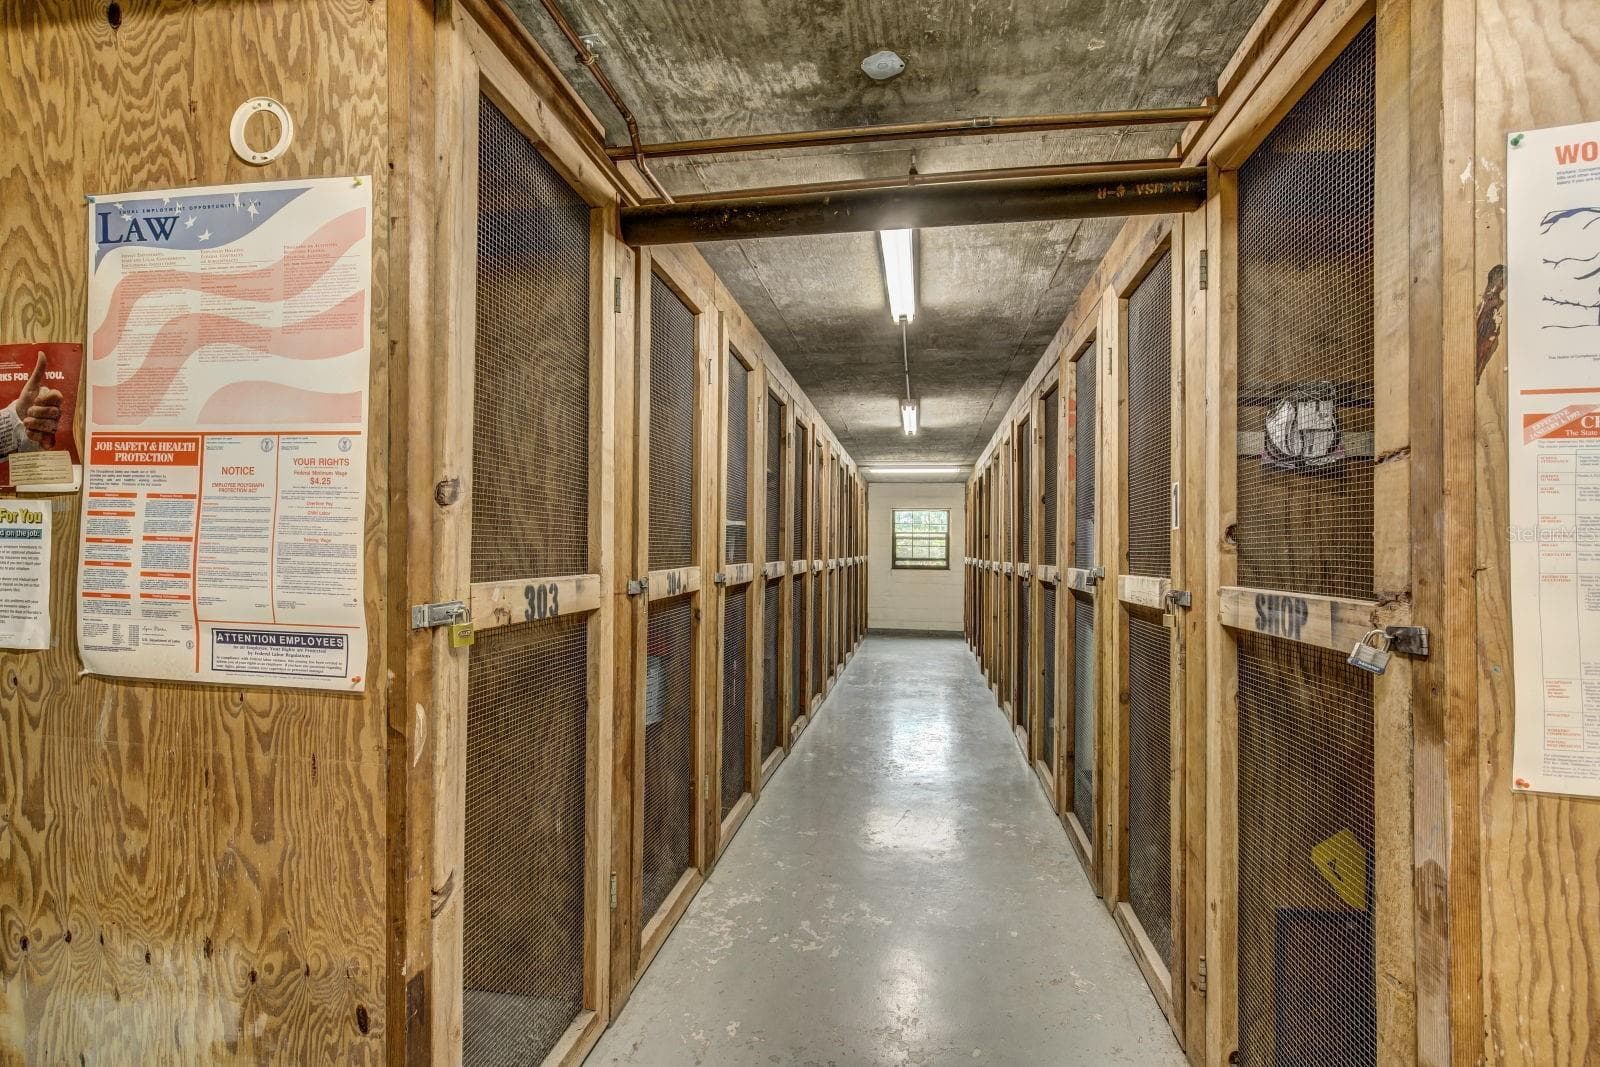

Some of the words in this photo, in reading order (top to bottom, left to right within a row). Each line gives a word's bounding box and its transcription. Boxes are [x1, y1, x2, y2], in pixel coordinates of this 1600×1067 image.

[98, 212, 179, 244] LAW
[45, 371, 64, 379] YOU.
[95, 442, 113, 451] JOB
[159, 442, 196, 452] HEALTH
[115, 453, 174, 462] PROTECTION
[293, 458, 316, 466] YOUR
[318, 458, 350, 466] RIGHTS
[221, 466, 255, 475] NOTICE
[19, 508, 43, 524] You
[16, 529, 26, 537] the
[524, 583, 559, 621] 303
[1255, 593, 1308, 638] SHOP
[217, 633, 276, 644] ATTENTION
[279, 635, 343, 647] EMPLOYEES
